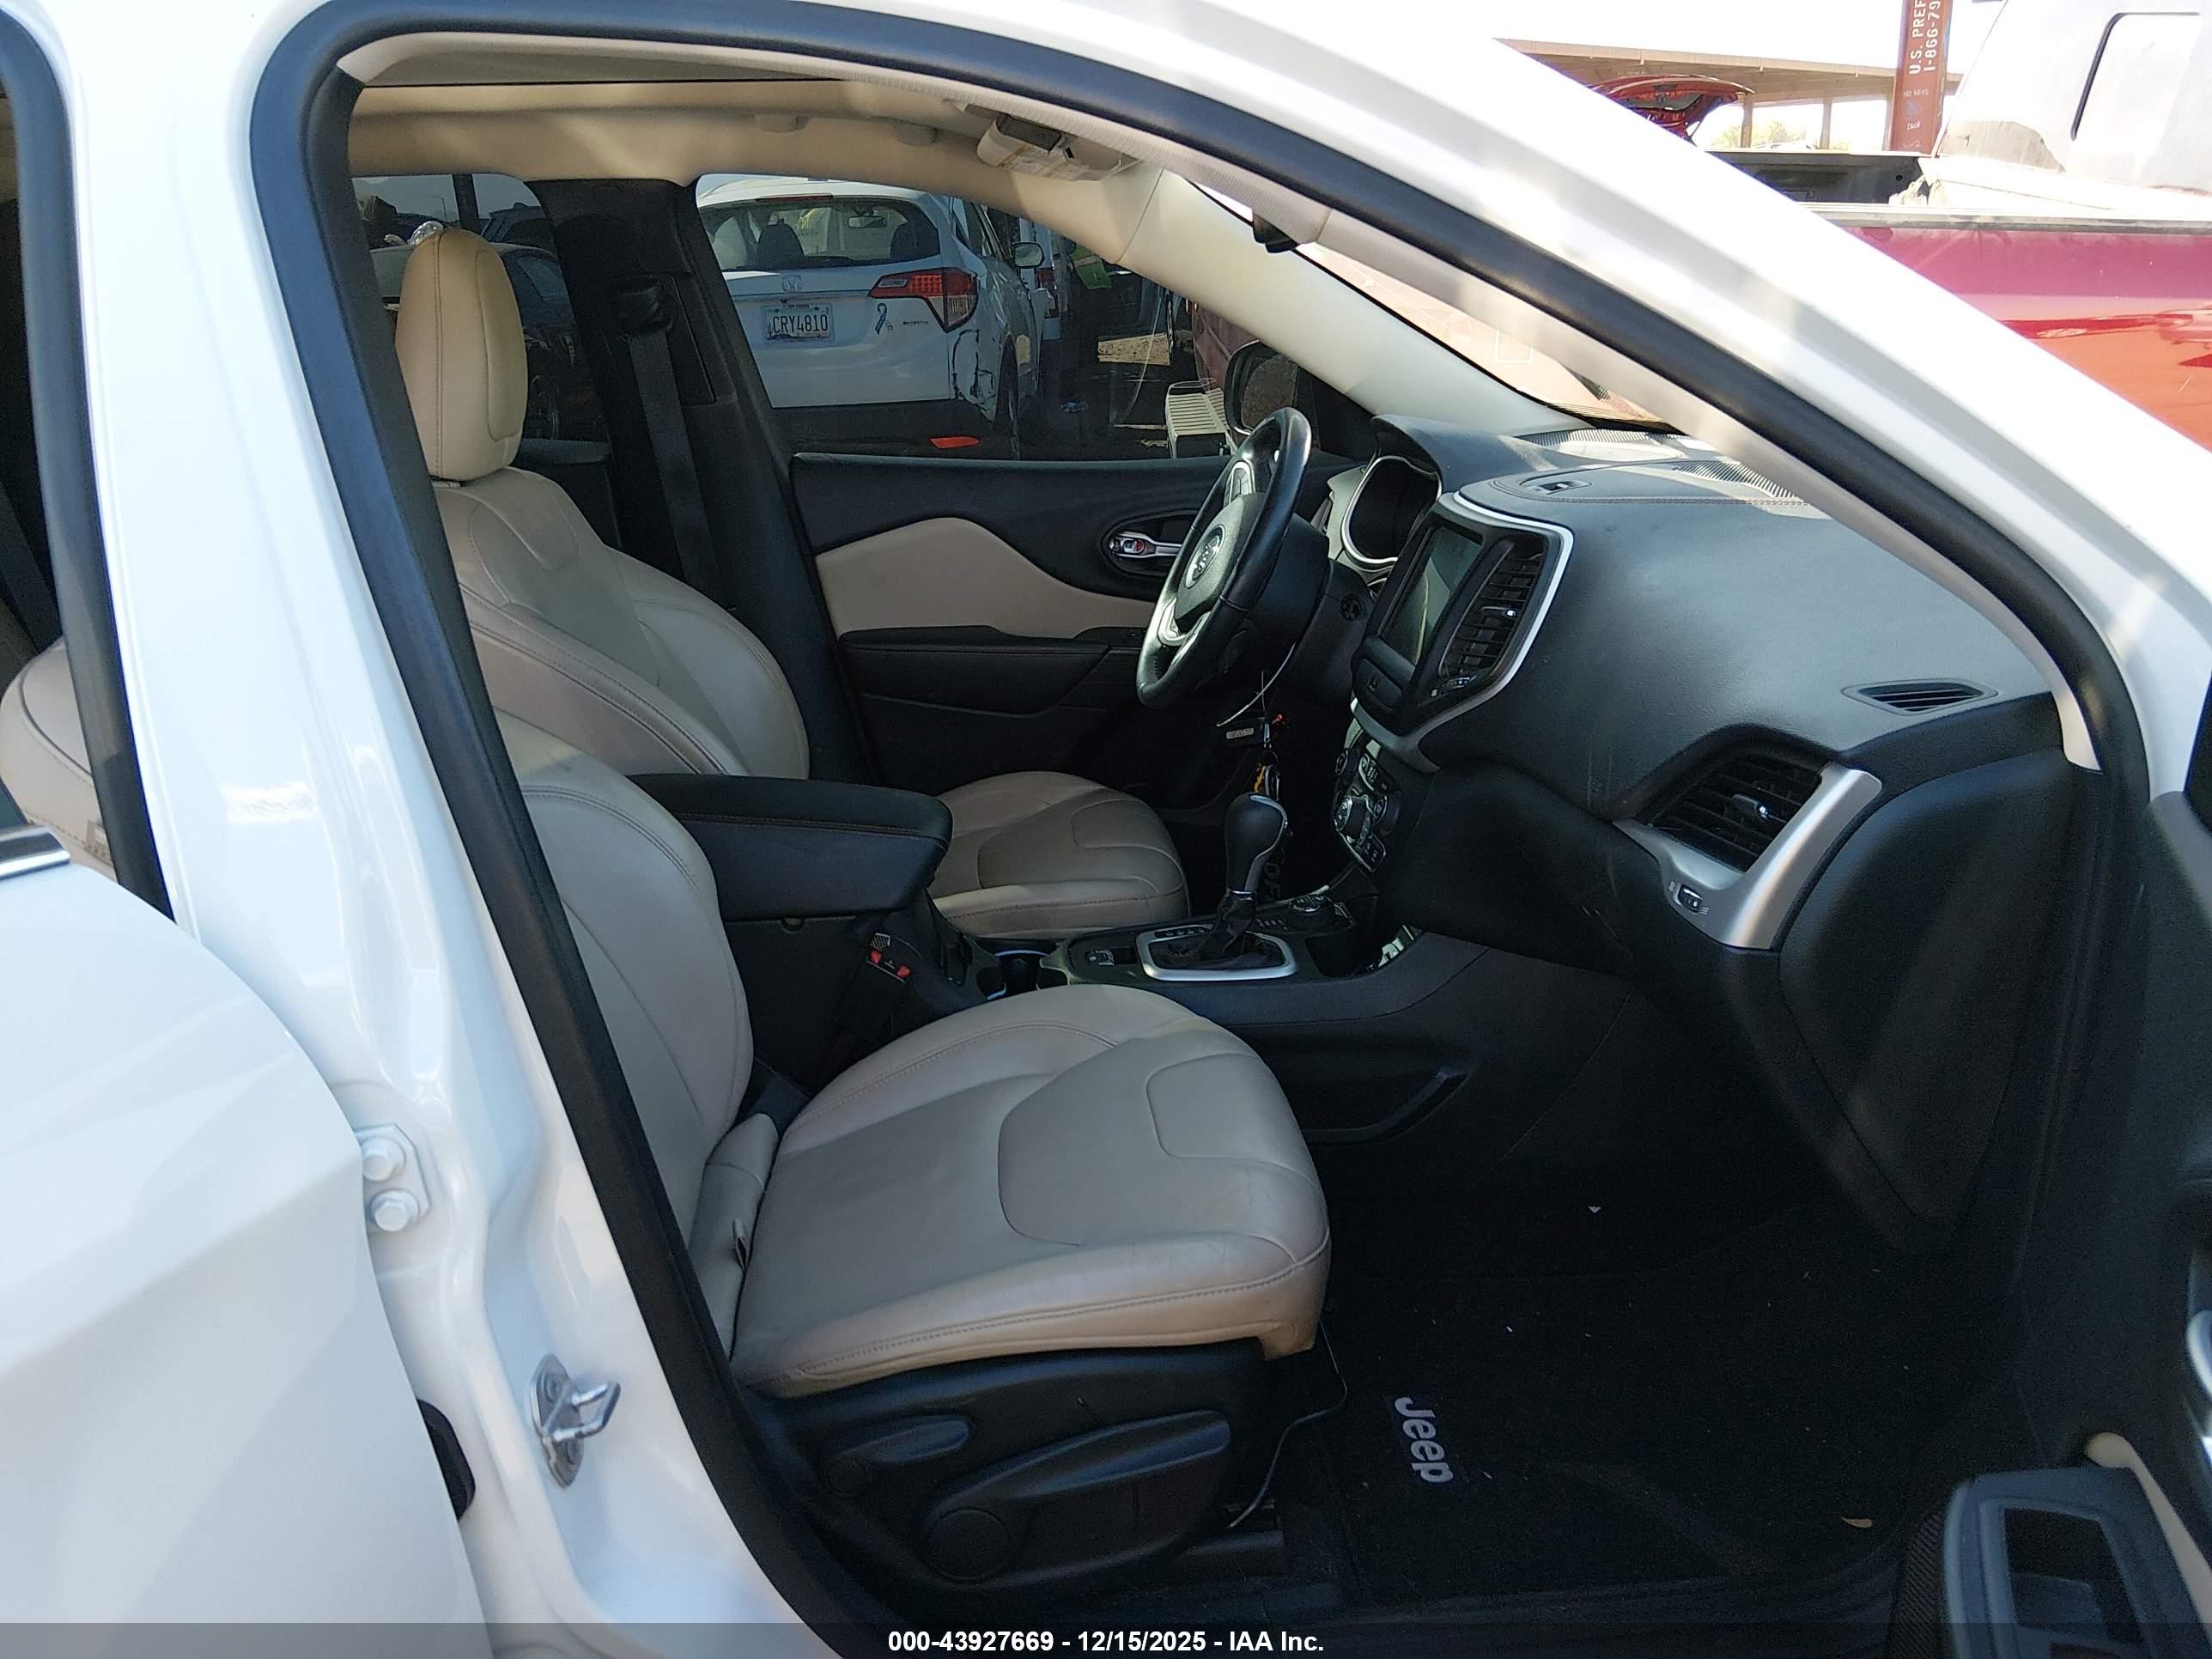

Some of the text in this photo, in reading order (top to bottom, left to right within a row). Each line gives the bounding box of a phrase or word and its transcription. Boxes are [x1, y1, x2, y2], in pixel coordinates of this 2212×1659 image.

[1909, 45, 1923, 75] U.S.
[773, 314, 829, 334] CRY4810
[1395, 1396, 1454, 1483] Jeep
